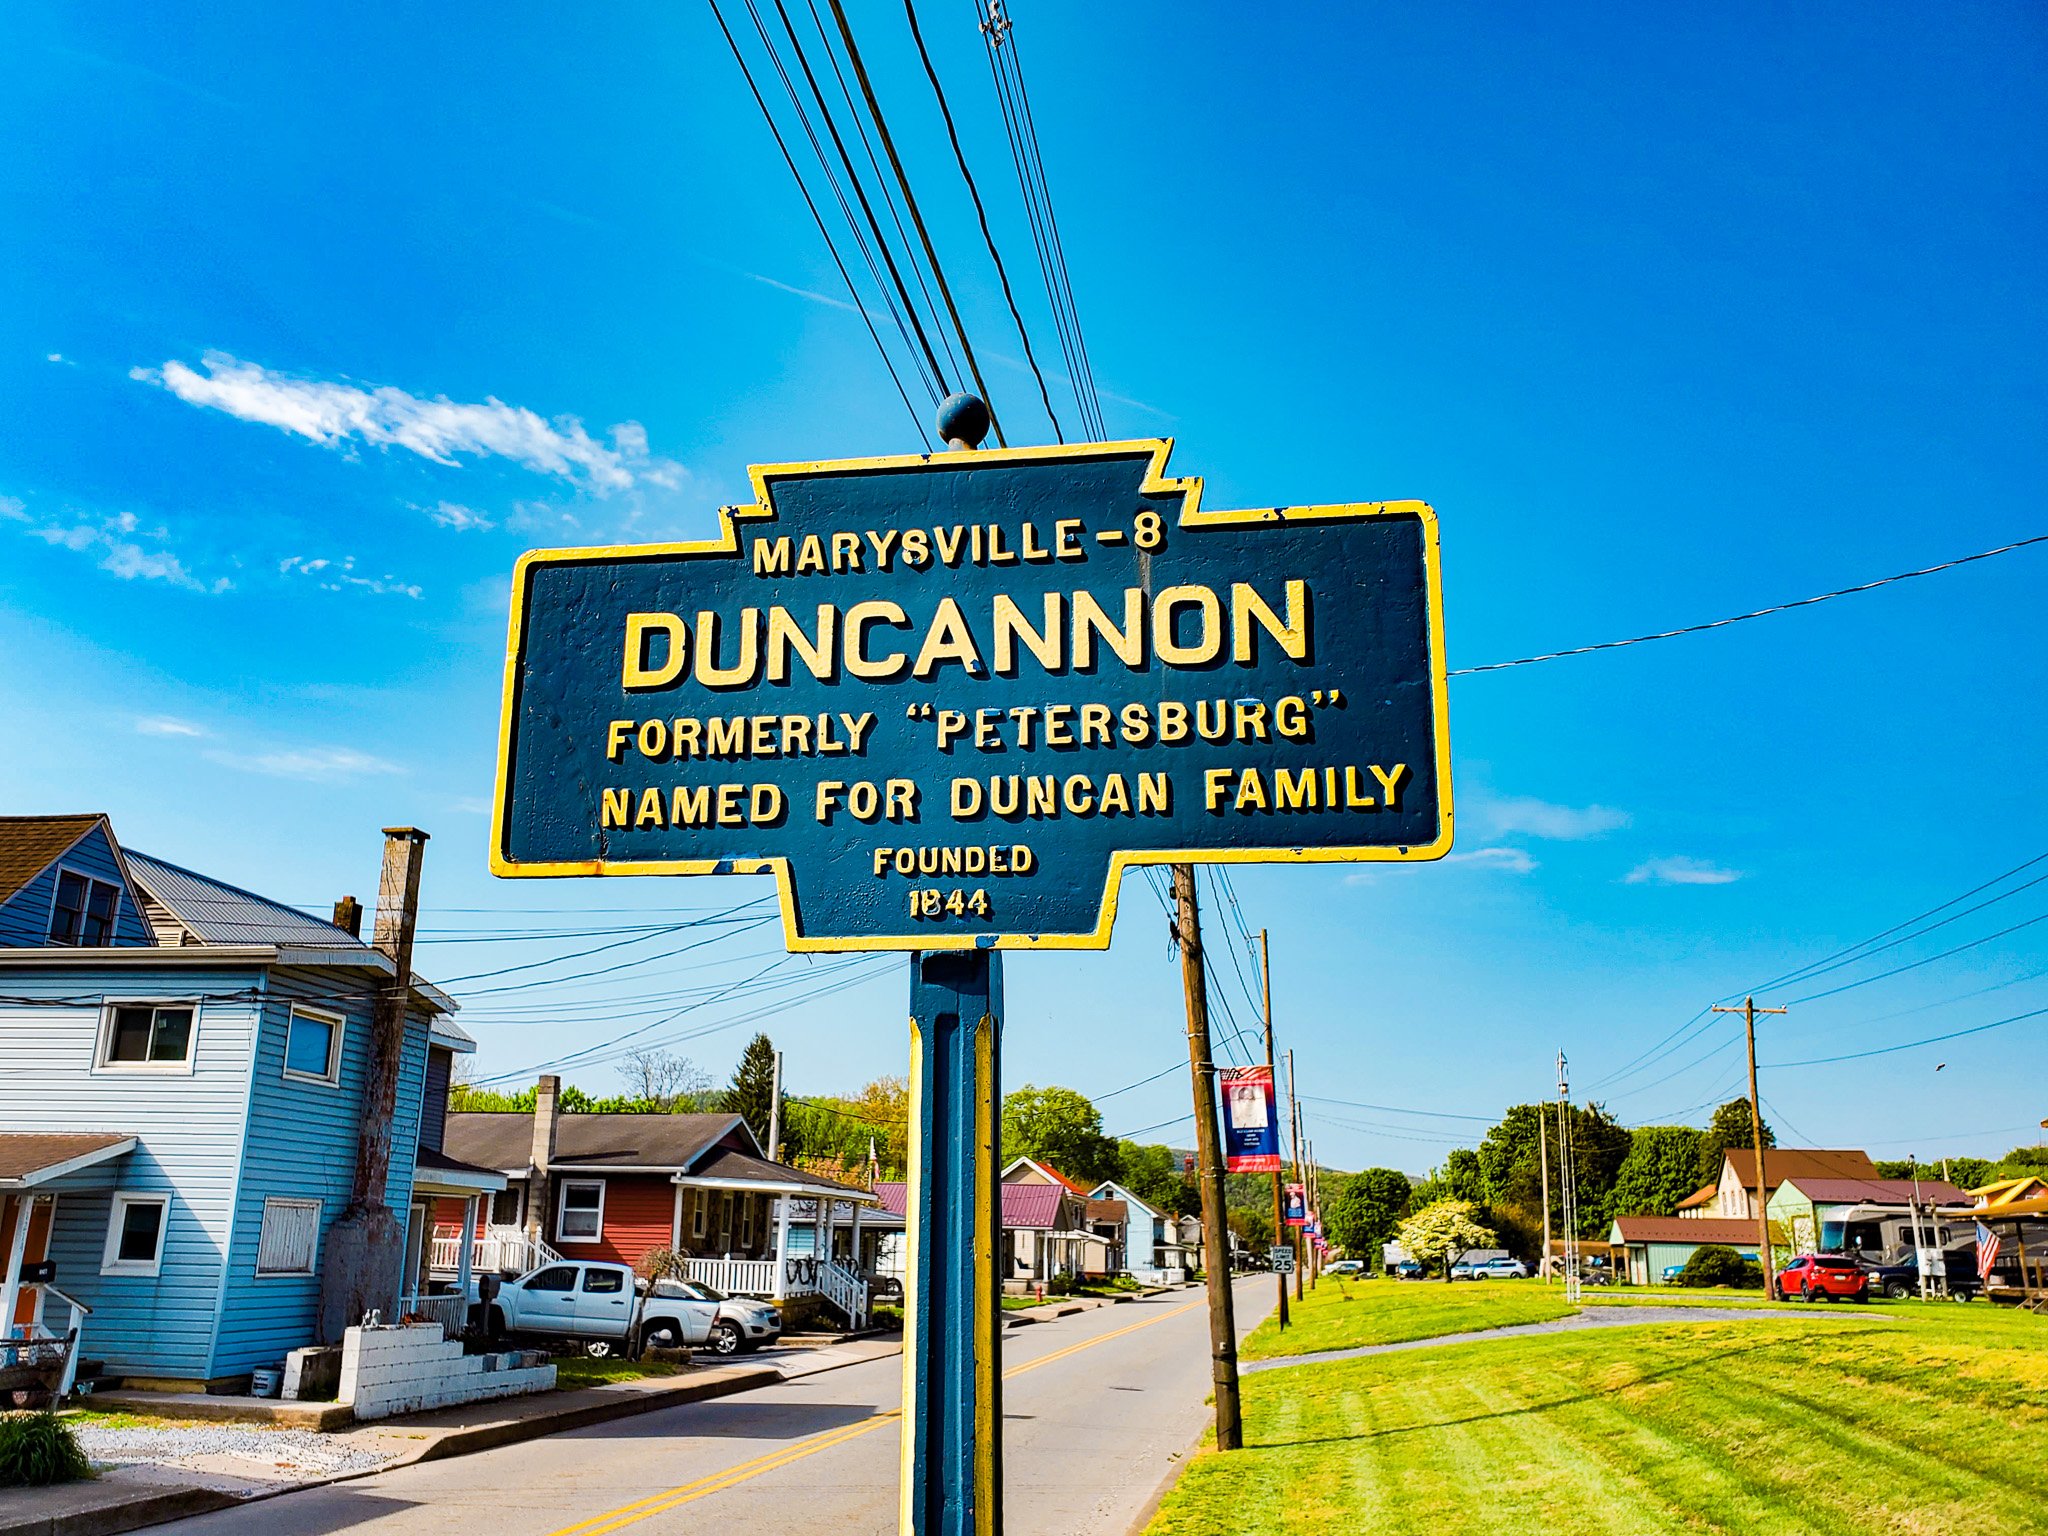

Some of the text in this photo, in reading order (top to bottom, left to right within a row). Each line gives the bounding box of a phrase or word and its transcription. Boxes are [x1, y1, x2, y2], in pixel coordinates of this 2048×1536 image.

[622, 579, 1307, 688] DUNCANNON
[606, 711, 874, 759] FORMERLY
[601, 763, 1407, 828] NAMED FOR DUNCAN FAMILY
[872, 844, 1033, 876] FOUNDED
[908, 888, 988, 918] 1844
[1275, 1260, 1292, 1271] 25
